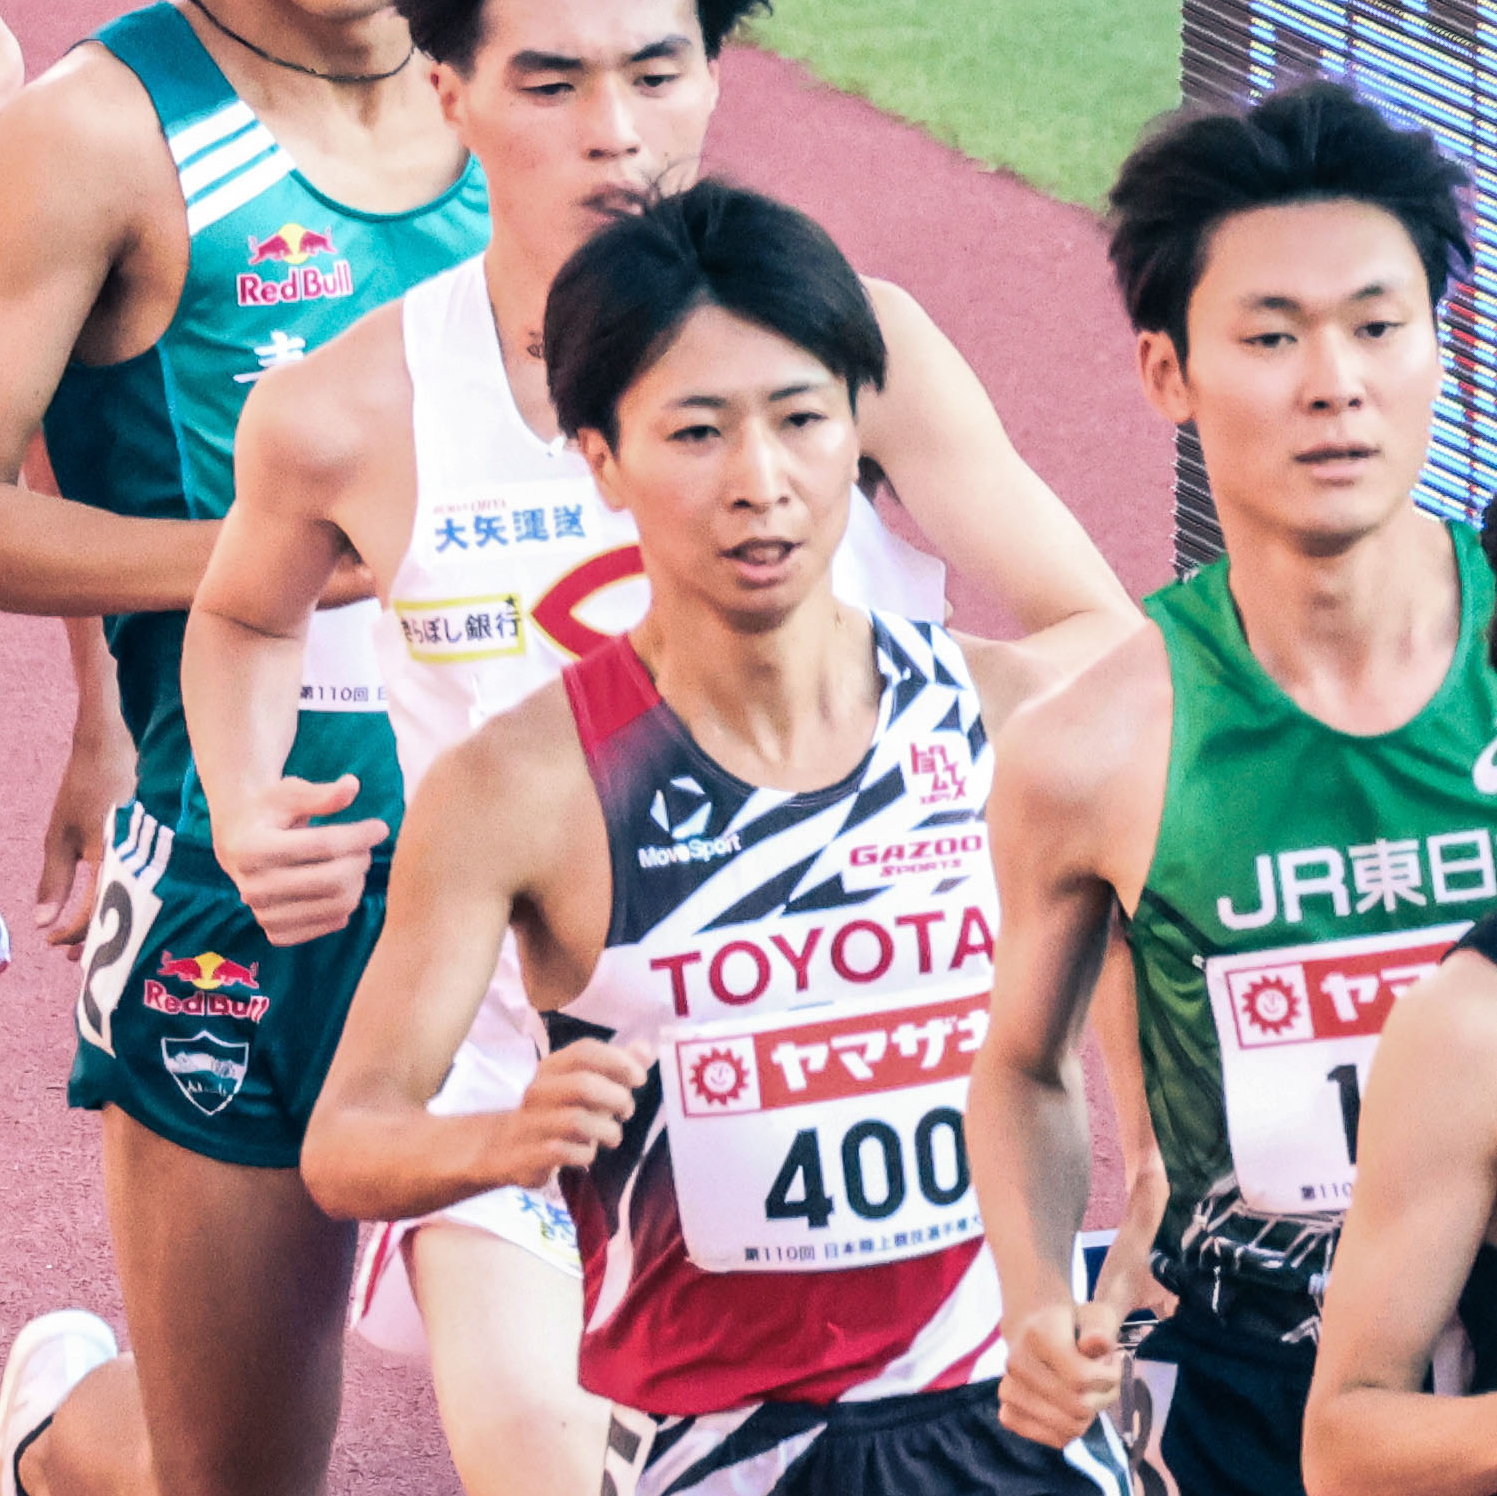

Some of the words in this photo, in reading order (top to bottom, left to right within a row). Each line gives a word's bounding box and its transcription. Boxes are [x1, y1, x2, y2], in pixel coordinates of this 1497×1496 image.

[435, 504, 586, 553] 大矢運送
[849, 835, 983, 867] GAZOO
[1216, 828, 1497, 930] JR東日
[649, 905, 994, 1017] TOYOTA
[764, 1106, 972, 1229] 400
[1301, 1182, 1354, 1201] 第110
